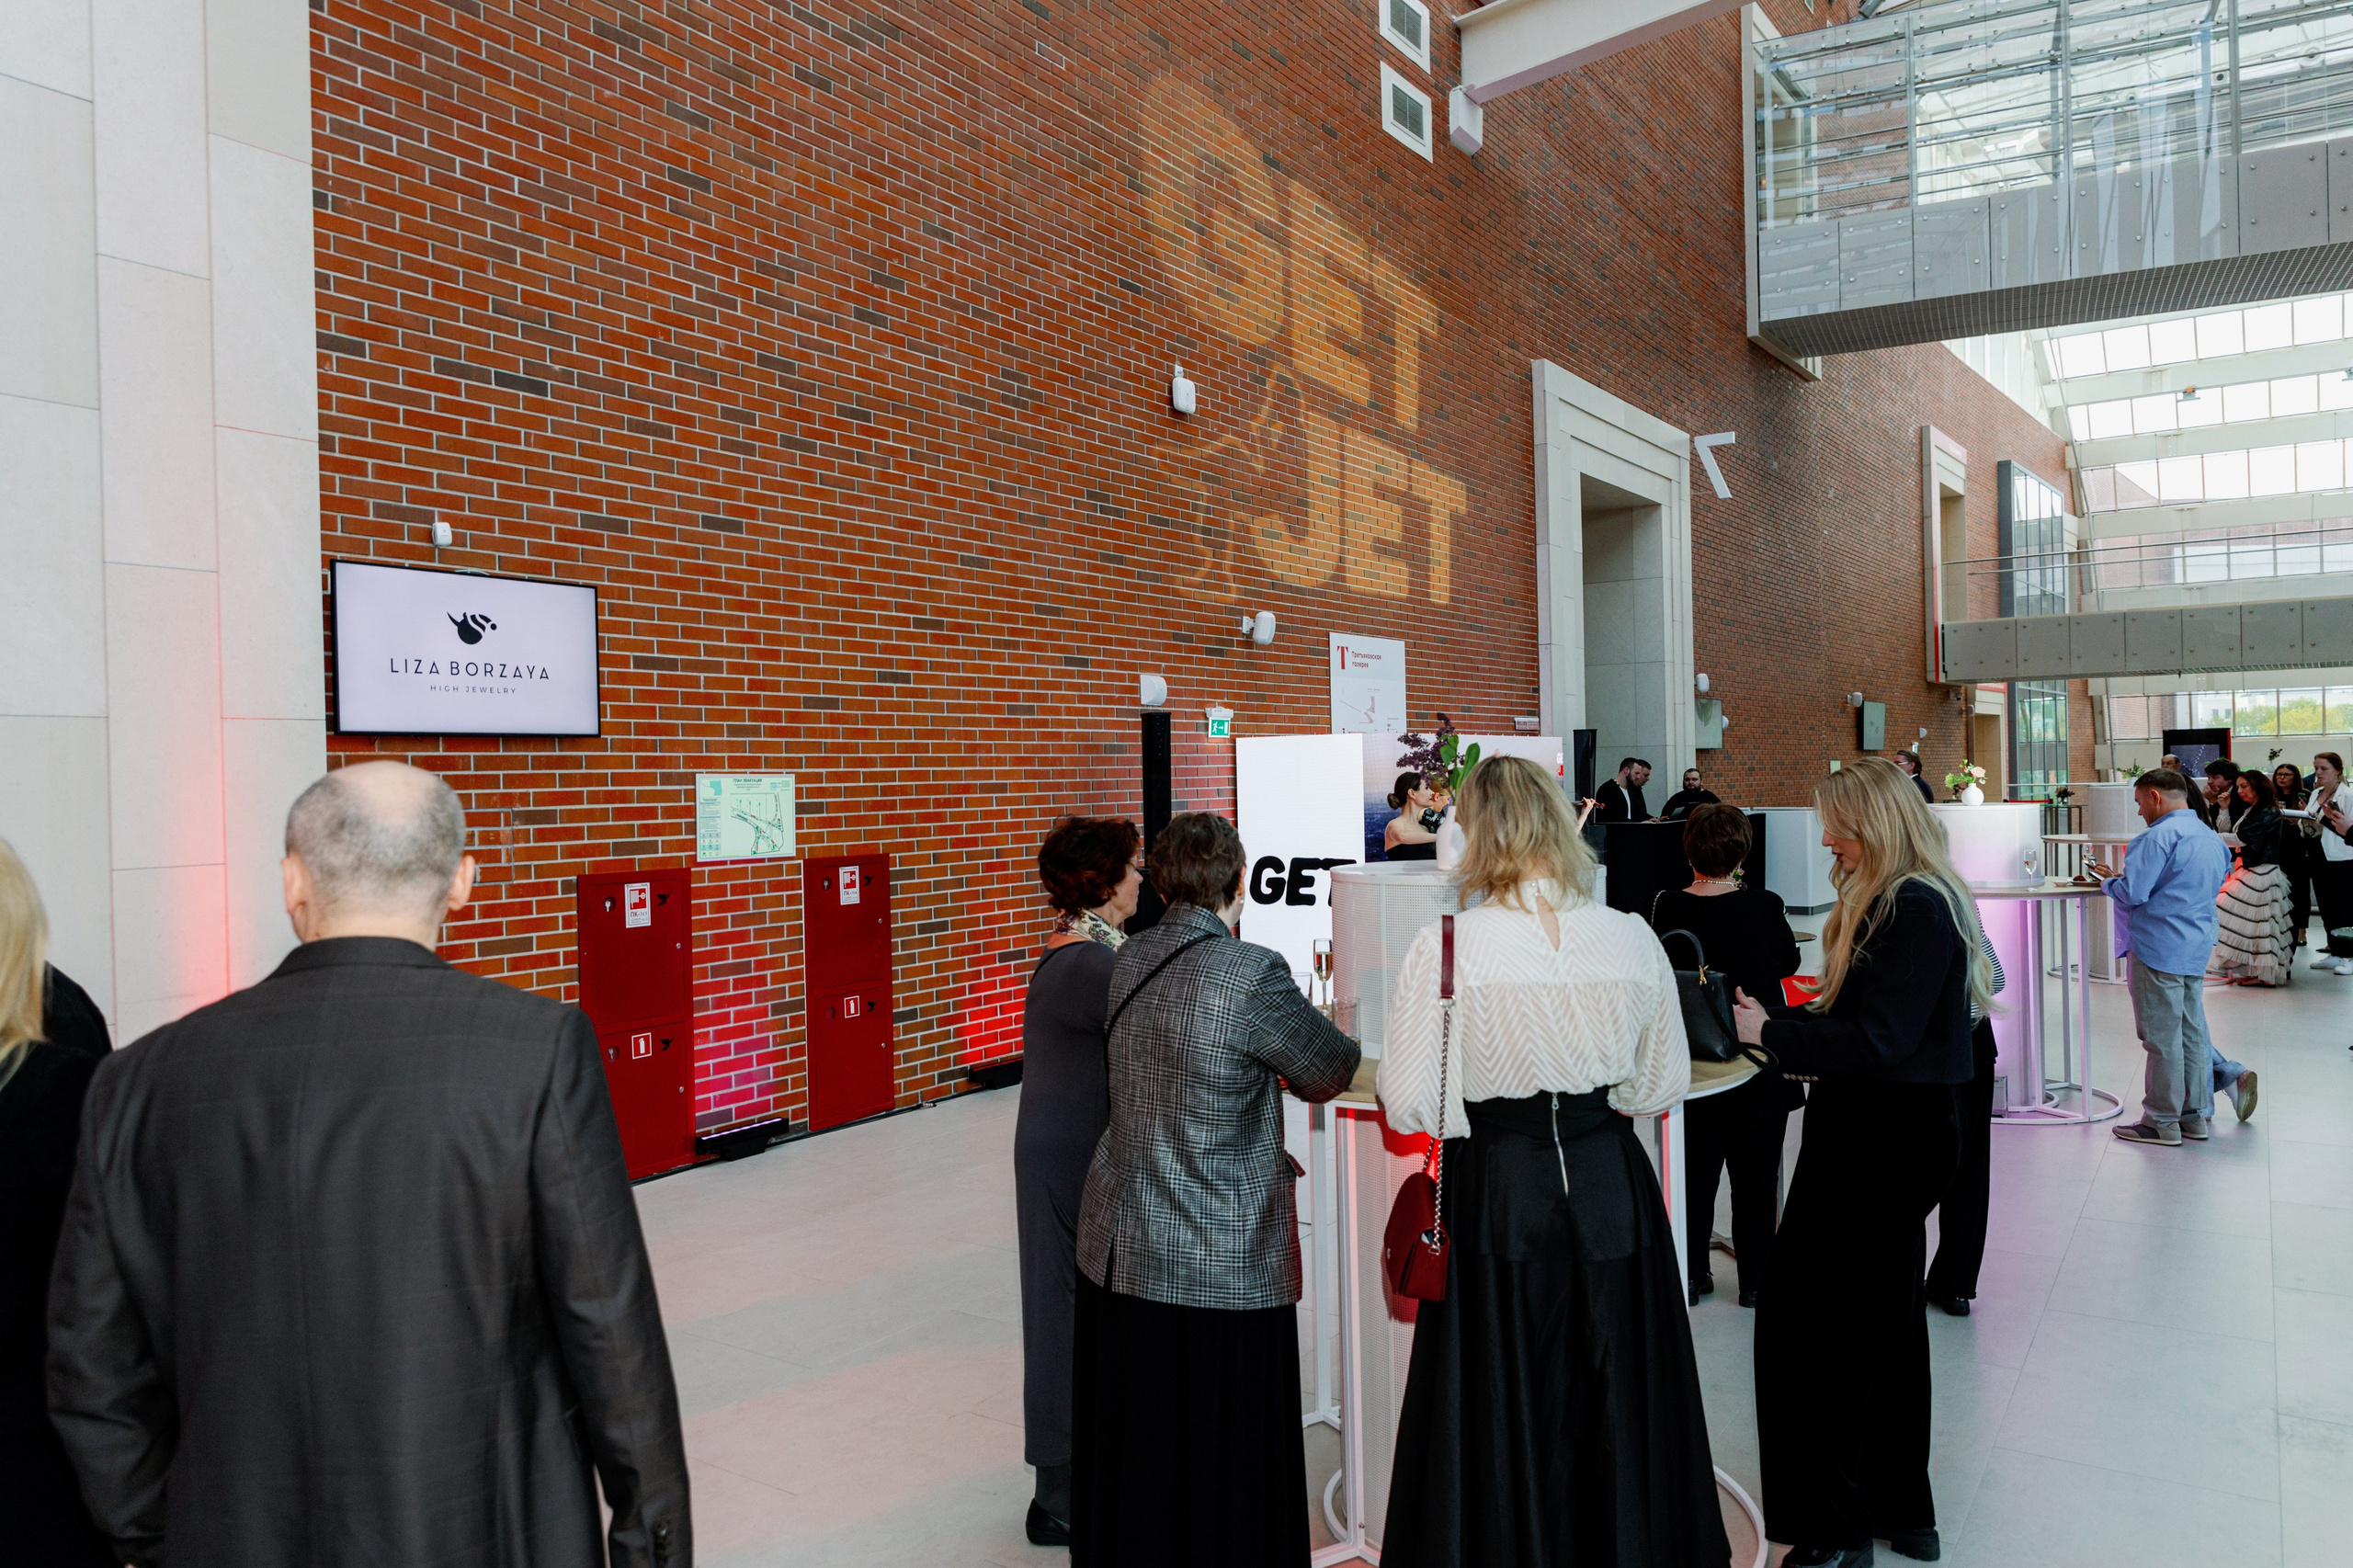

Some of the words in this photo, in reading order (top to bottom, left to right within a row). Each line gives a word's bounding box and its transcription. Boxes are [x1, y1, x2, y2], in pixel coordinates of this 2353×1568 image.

[1142, 72, 1438, 431] GET
[1252, 412, 1467, 605] JET
[1351, 651, 1382, 661] Третьяковская
[1351, 661, 1370, 669] галерея
[390, 657, 440, 676] LIZA
[449, 661, 550, 680] BORZAYA
